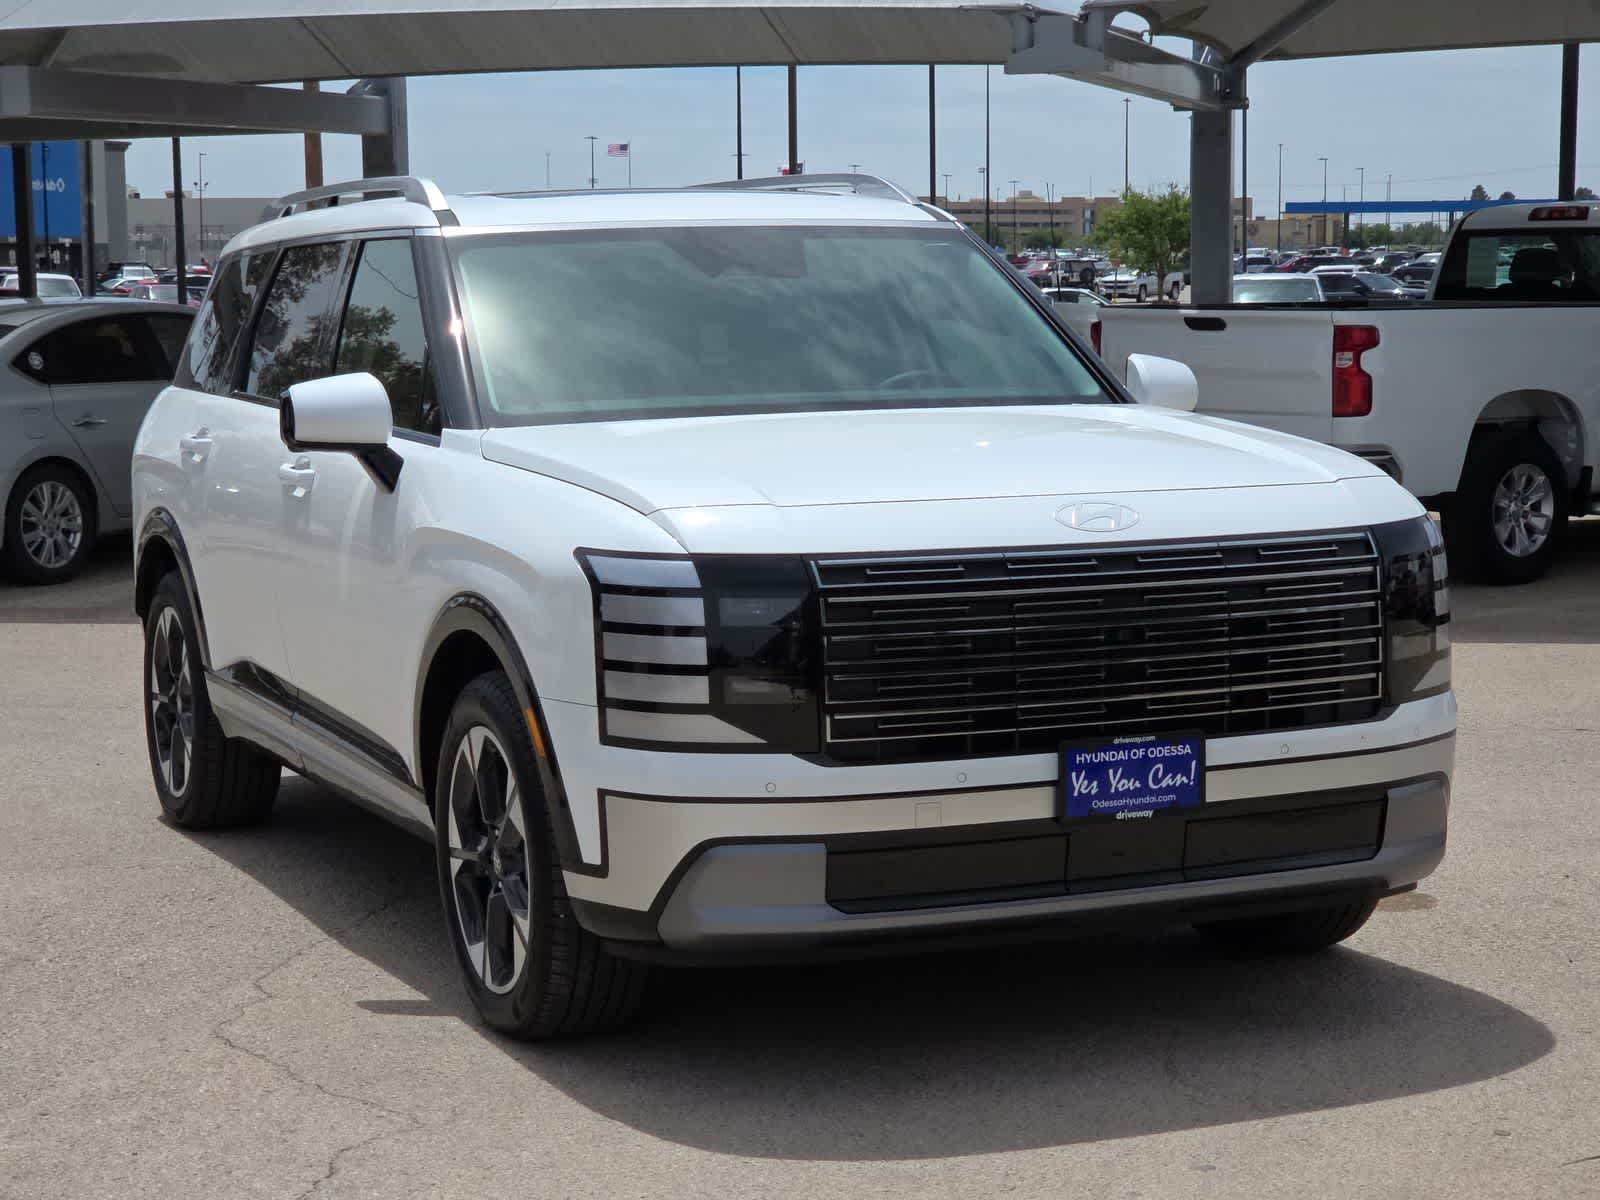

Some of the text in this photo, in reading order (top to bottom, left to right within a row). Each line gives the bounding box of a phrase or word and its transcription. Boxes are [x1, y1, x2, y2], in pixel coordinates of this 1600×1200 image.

[1113, 735, 1155, 744] driveway.com
[1076, 744, 1192, 764] HYUNDAI OF ODESSA
[1071, 760, 1196, 797] Yes You Can!
[1092, 794, 1176, 809] OdessaHyundai.com
[1115, 809, 1154, 820] driveway
